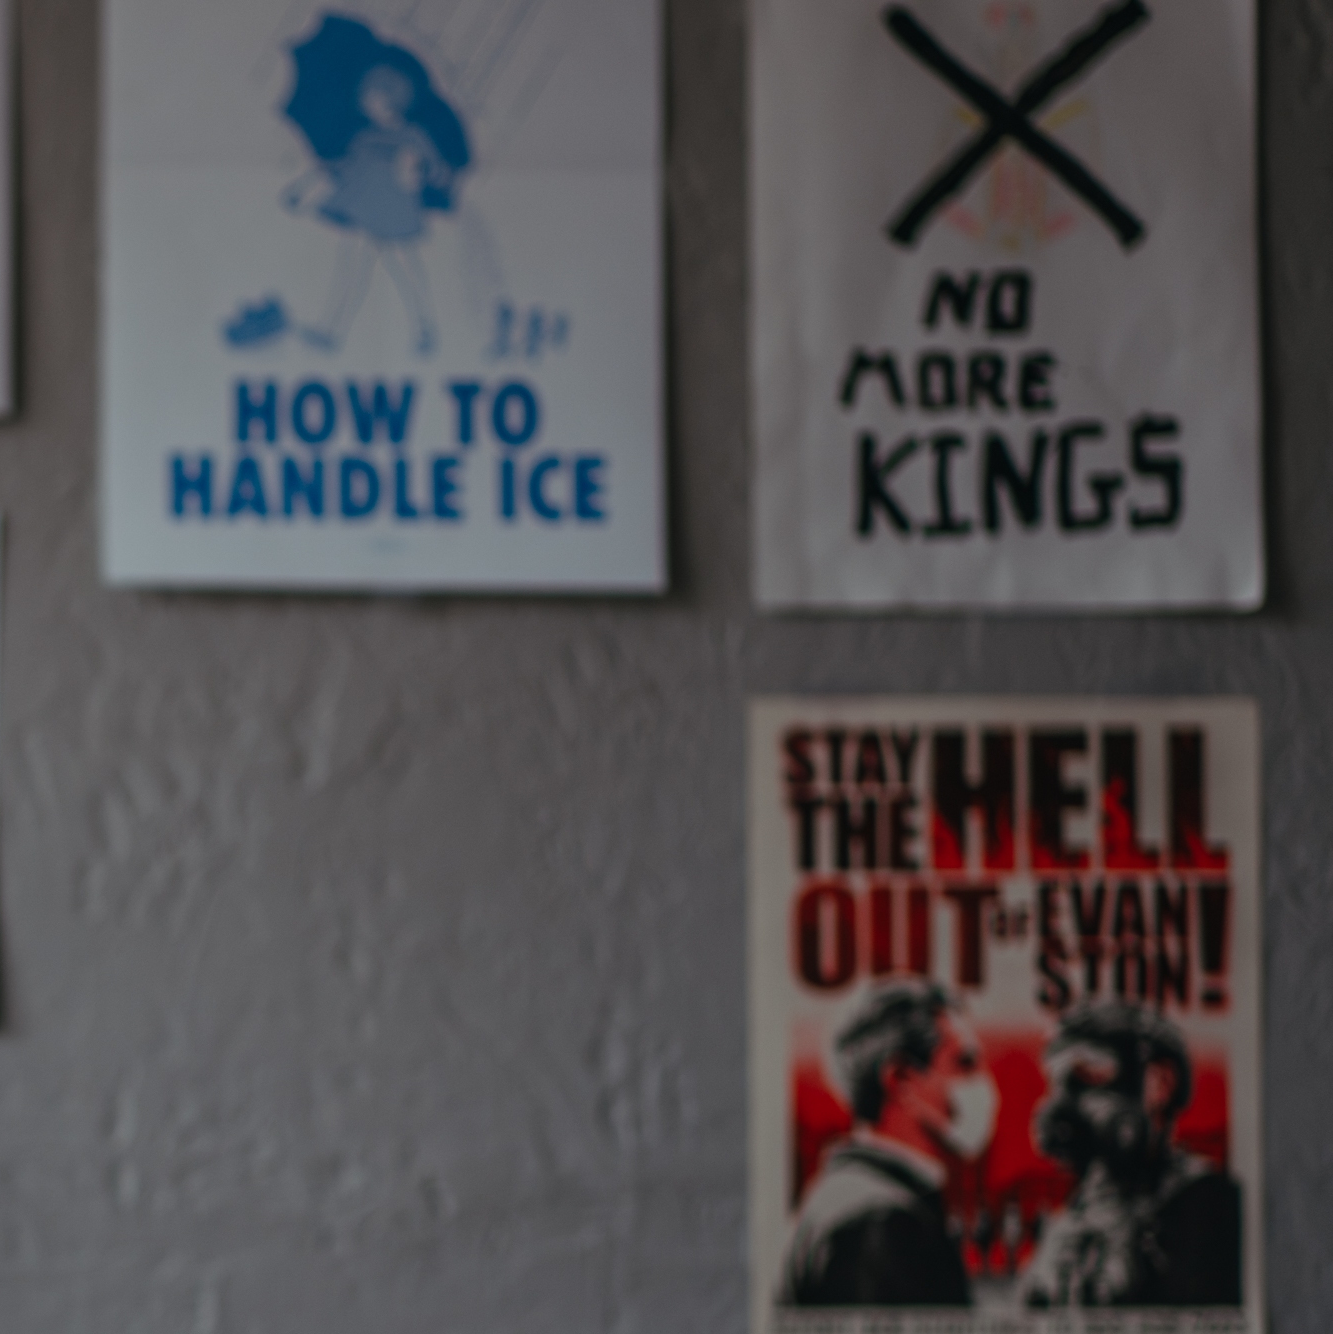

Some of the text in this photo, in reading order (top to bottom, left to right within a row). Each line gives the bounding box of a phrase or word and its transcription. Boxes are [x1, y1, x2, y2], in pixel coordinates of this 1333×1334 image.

[922, 269, 1031, 335] NO
[840, 346, 1057, 412] MORE
[233, 381, 540, 446] HOW TO
[168, 456, 607, 522] HANDLE ICE
[855, 415, 1183, 537] KINGS
[782, 727, 921, 788] STAY
[787, 726, 1230, 870] THE HELL
[794, 881, 999, 992] OUT
